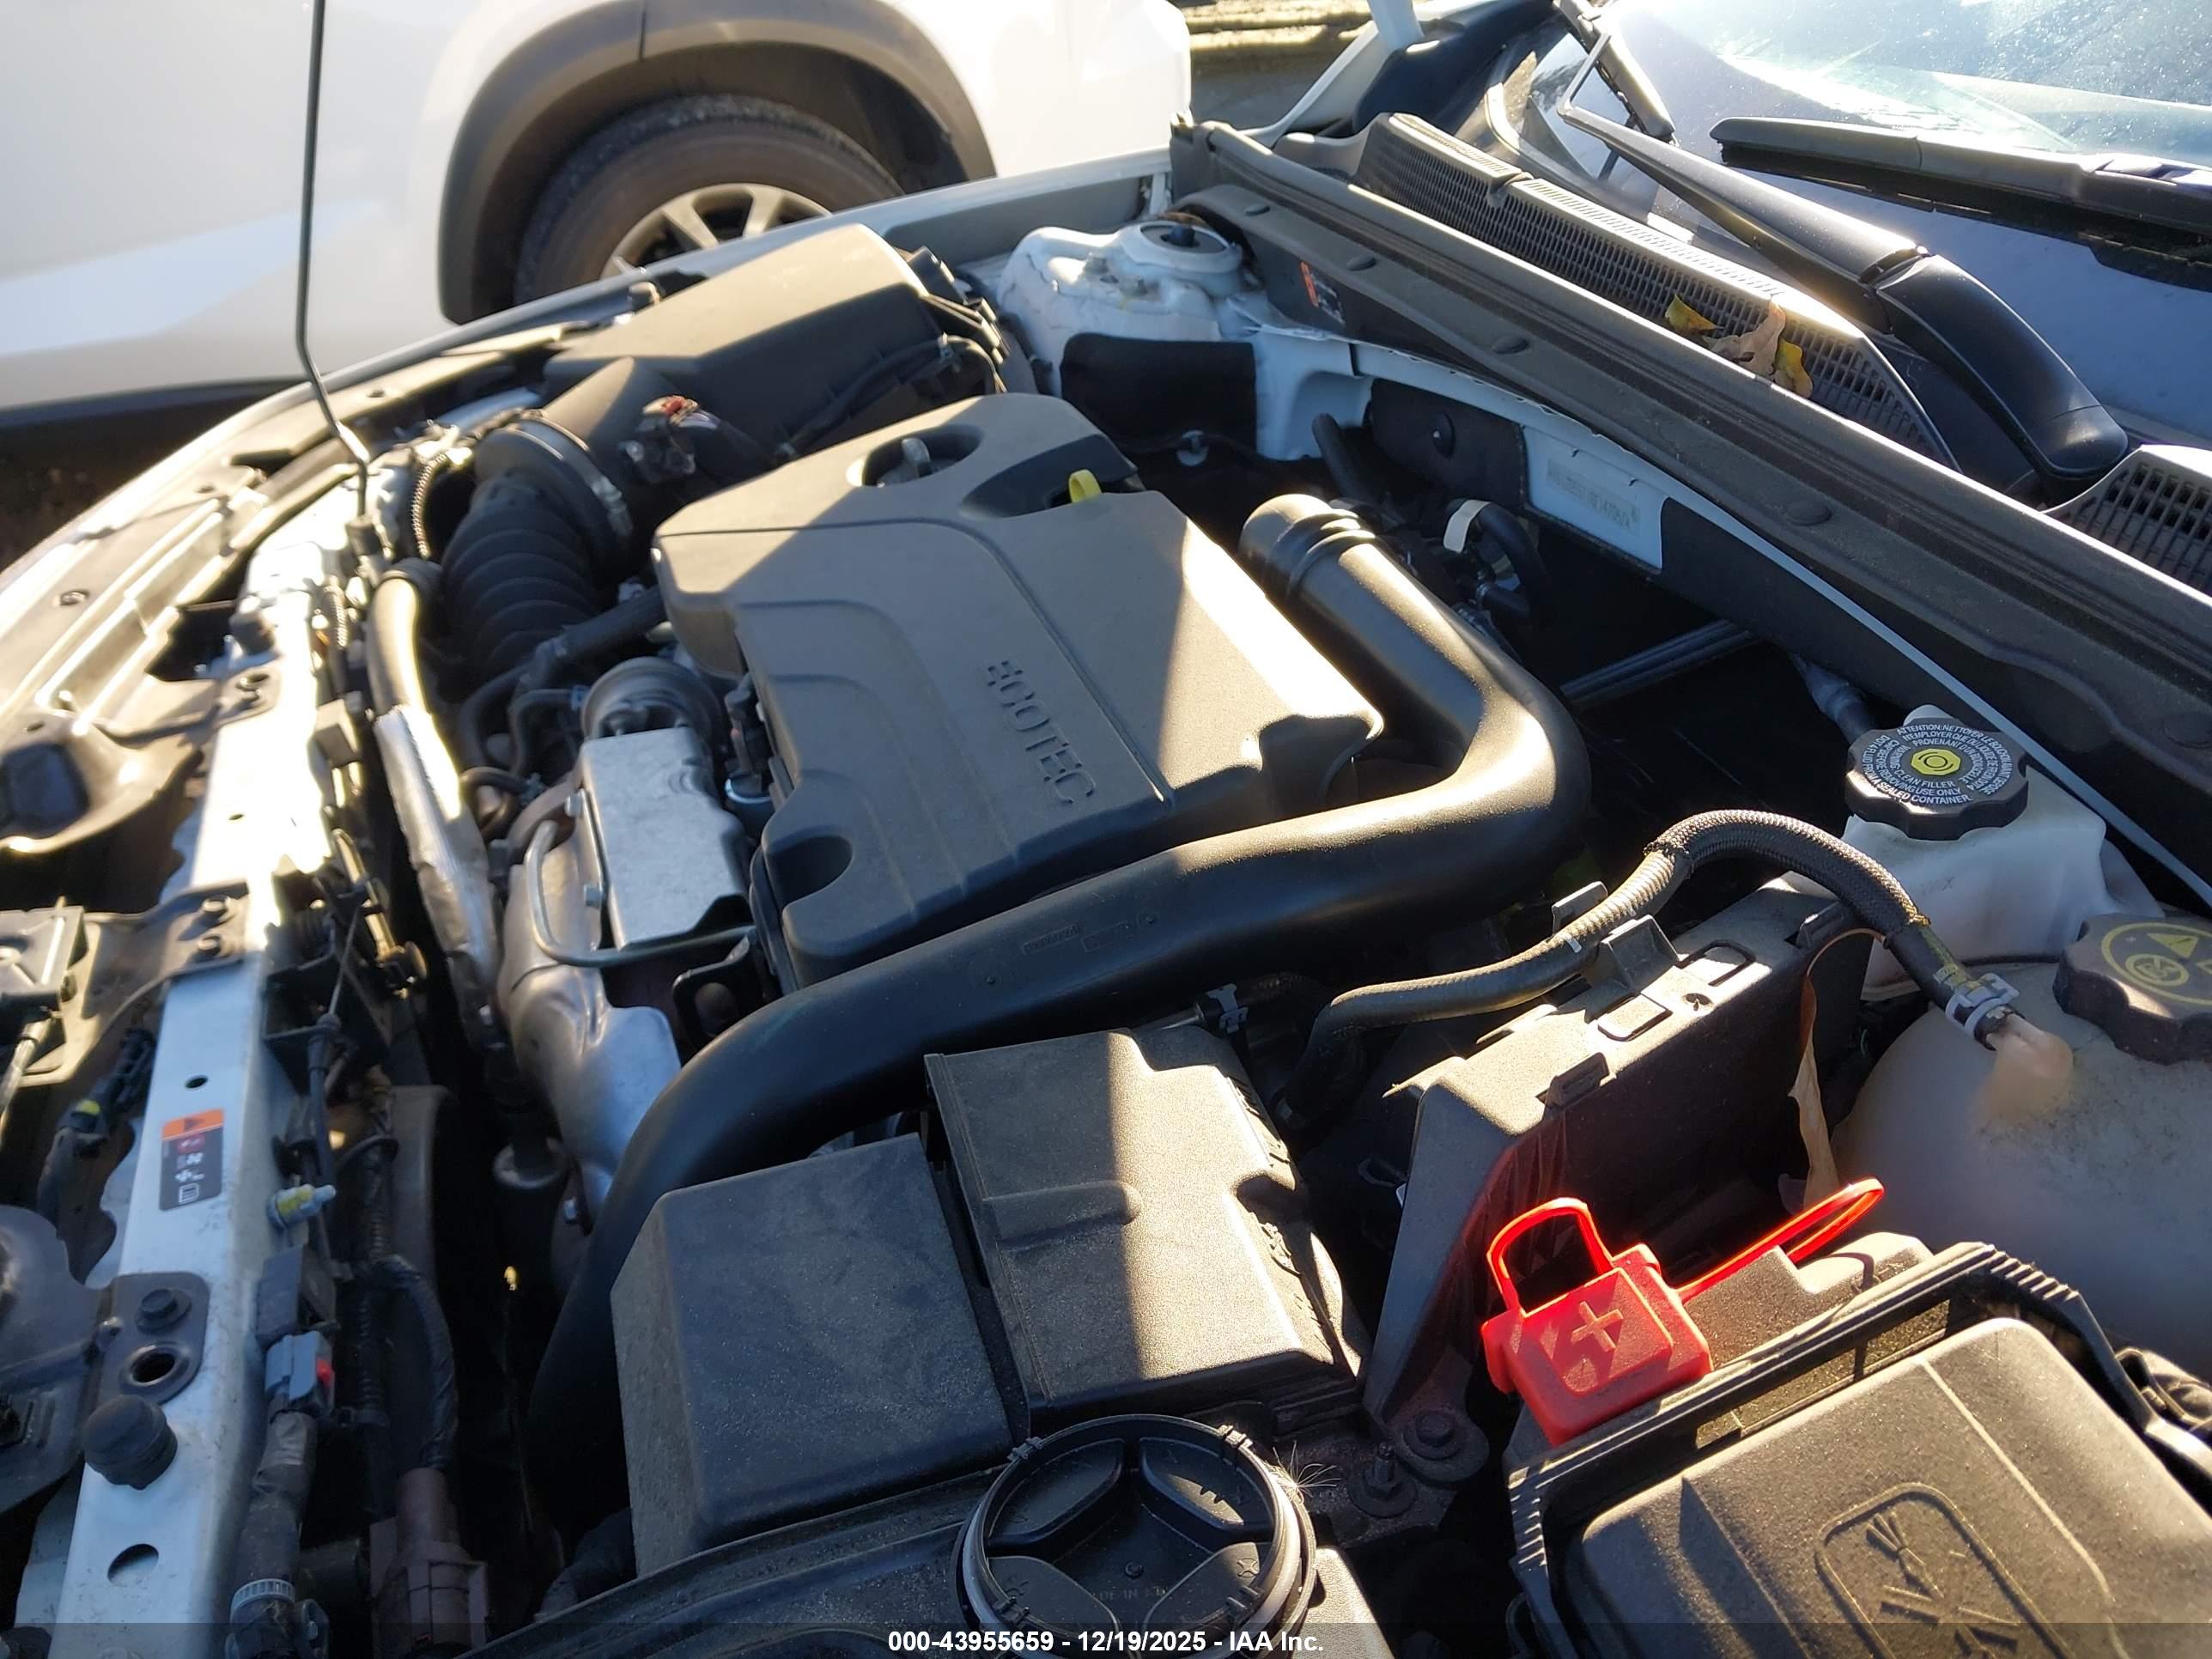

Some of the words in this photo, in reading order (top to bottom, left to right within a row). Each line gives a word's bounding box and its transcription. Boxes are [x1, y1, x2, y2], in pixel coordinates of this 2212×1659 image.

[988, 660, 1097, 805] ECOTEC
[1942, 724, 1984, 738] NETTOYER
[1980, 735, 1995, 744] LE
[1952, 732, 1971, 742] QUE
[1912, 738, 1962, 748] PROVENANT
[1893, 769, 1921, 786] CLEAN
[1921, 780, 1957, 789] FILLER
[1876, 781, 1911, 800] SEALED
[1915, 787, 1936, 796] USE
[1936, 787, 1961, 796] ONLY
